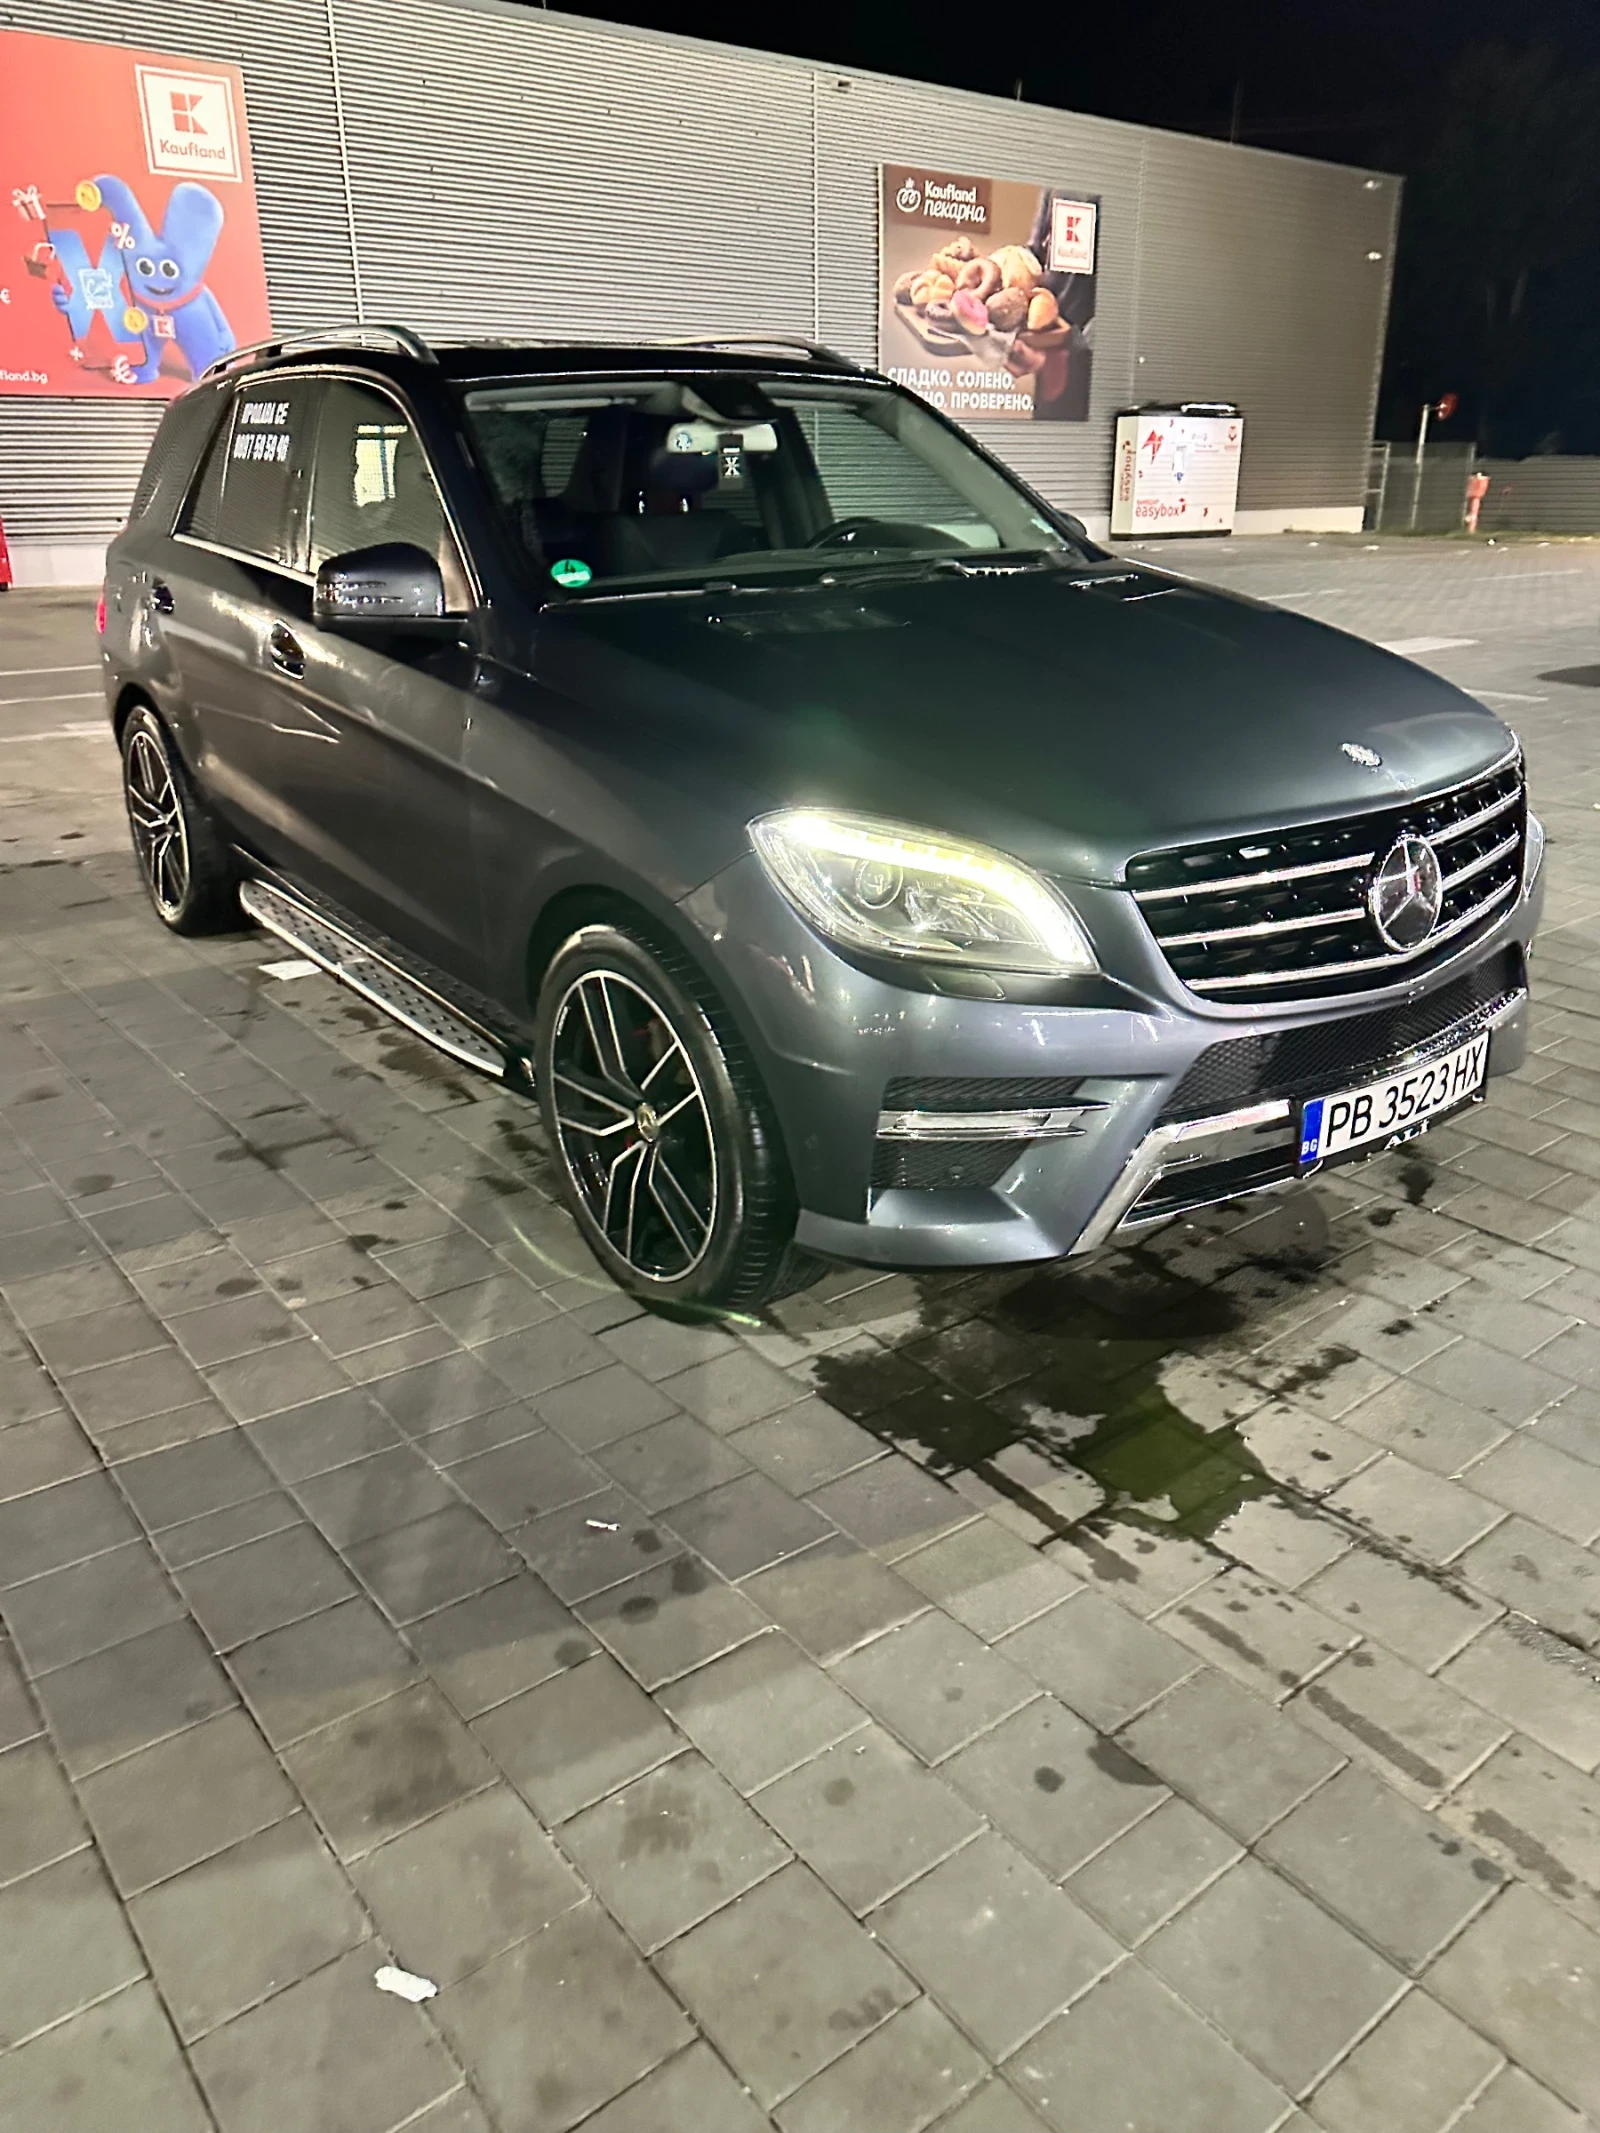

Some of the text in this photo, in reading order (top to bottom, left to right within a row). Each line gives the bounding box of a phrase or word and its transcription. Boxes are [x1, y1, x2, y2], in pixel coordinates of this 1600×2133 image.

[169, 91, 209, 135] K
[159, 138, 227, 160] Kaufland
[924, 179, 977, 203] Kaufland
[923, 198, 987, 224] пекарна
[950, 391, 1035, 411] ПРОВЕРЕНО.
[1135, 503, 1180, 520] easybox
[1325, 1041, 1484, 1148] PB 3523 HX
[1301, 1140, 1318, 1154] BG
